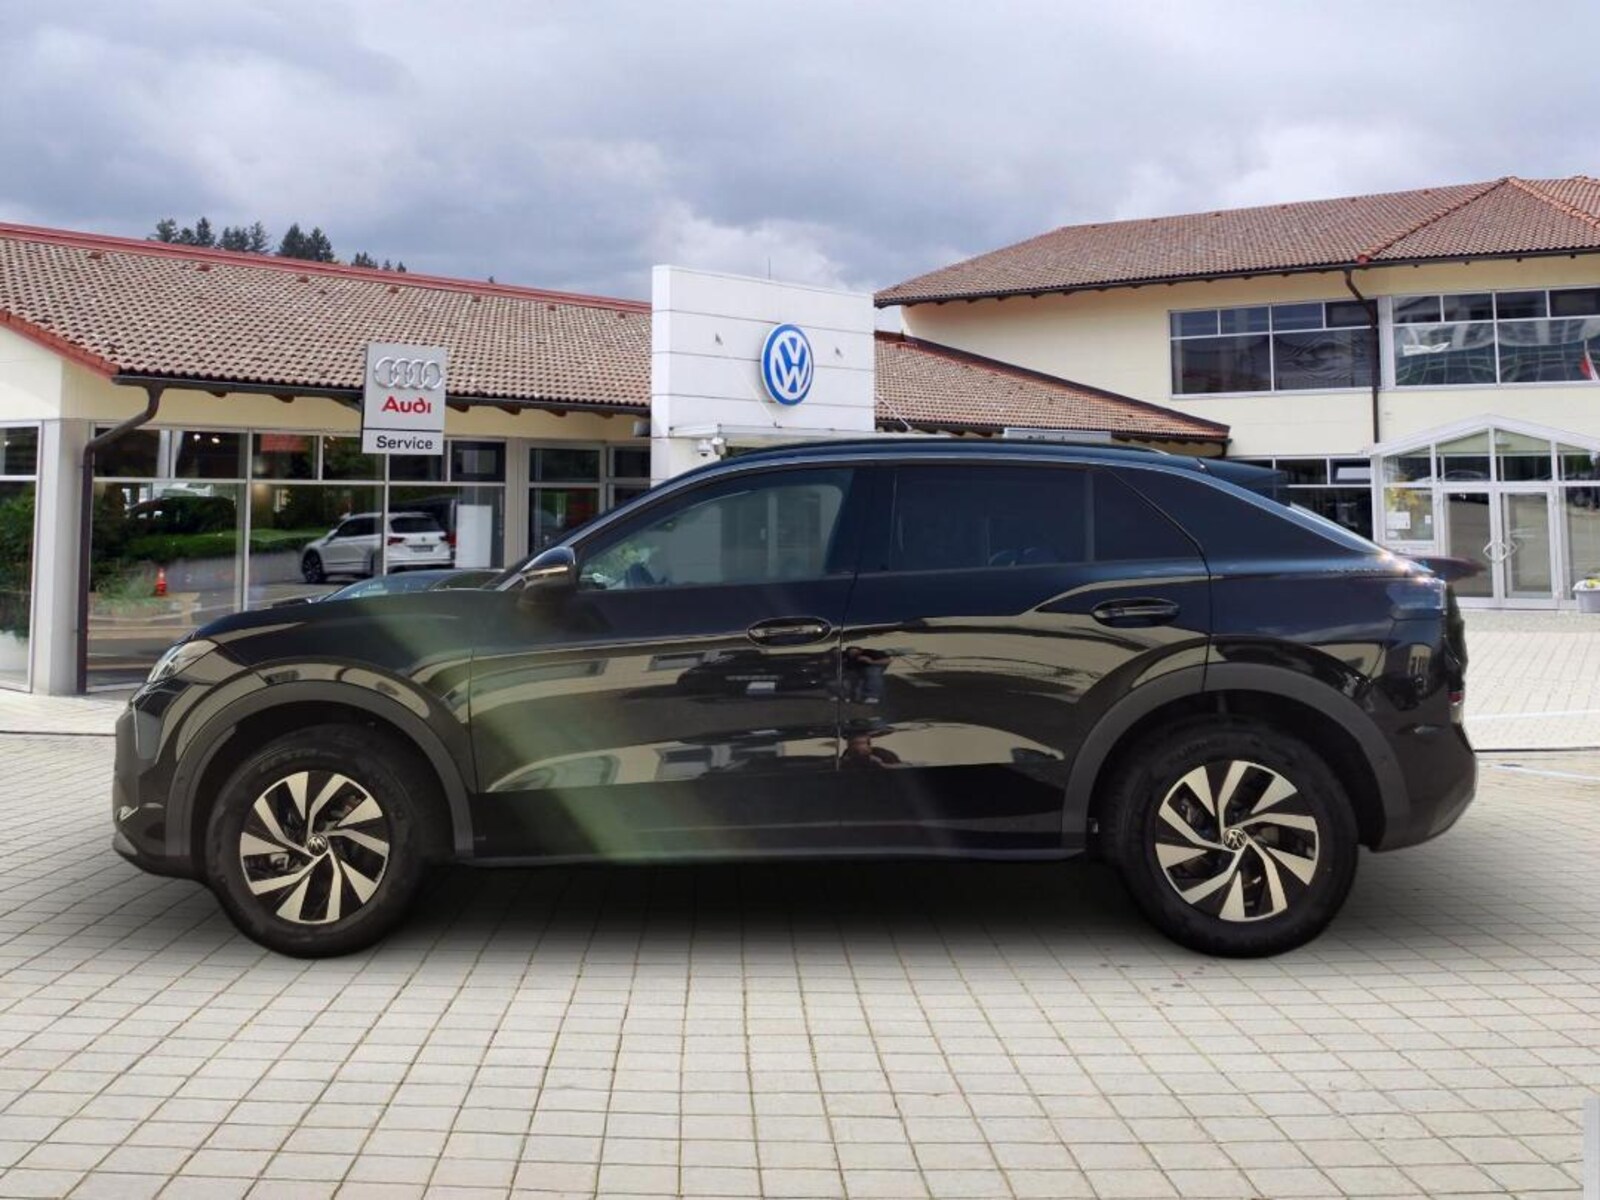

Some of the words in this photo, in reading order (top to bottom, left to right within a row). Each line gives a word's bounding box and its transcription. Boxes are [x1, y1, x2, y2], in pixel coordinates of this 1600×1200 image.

[767, 328, 811, 402] VW
[382, 396, 432, 413] Audi
[376, 435, 433, 449] Service
